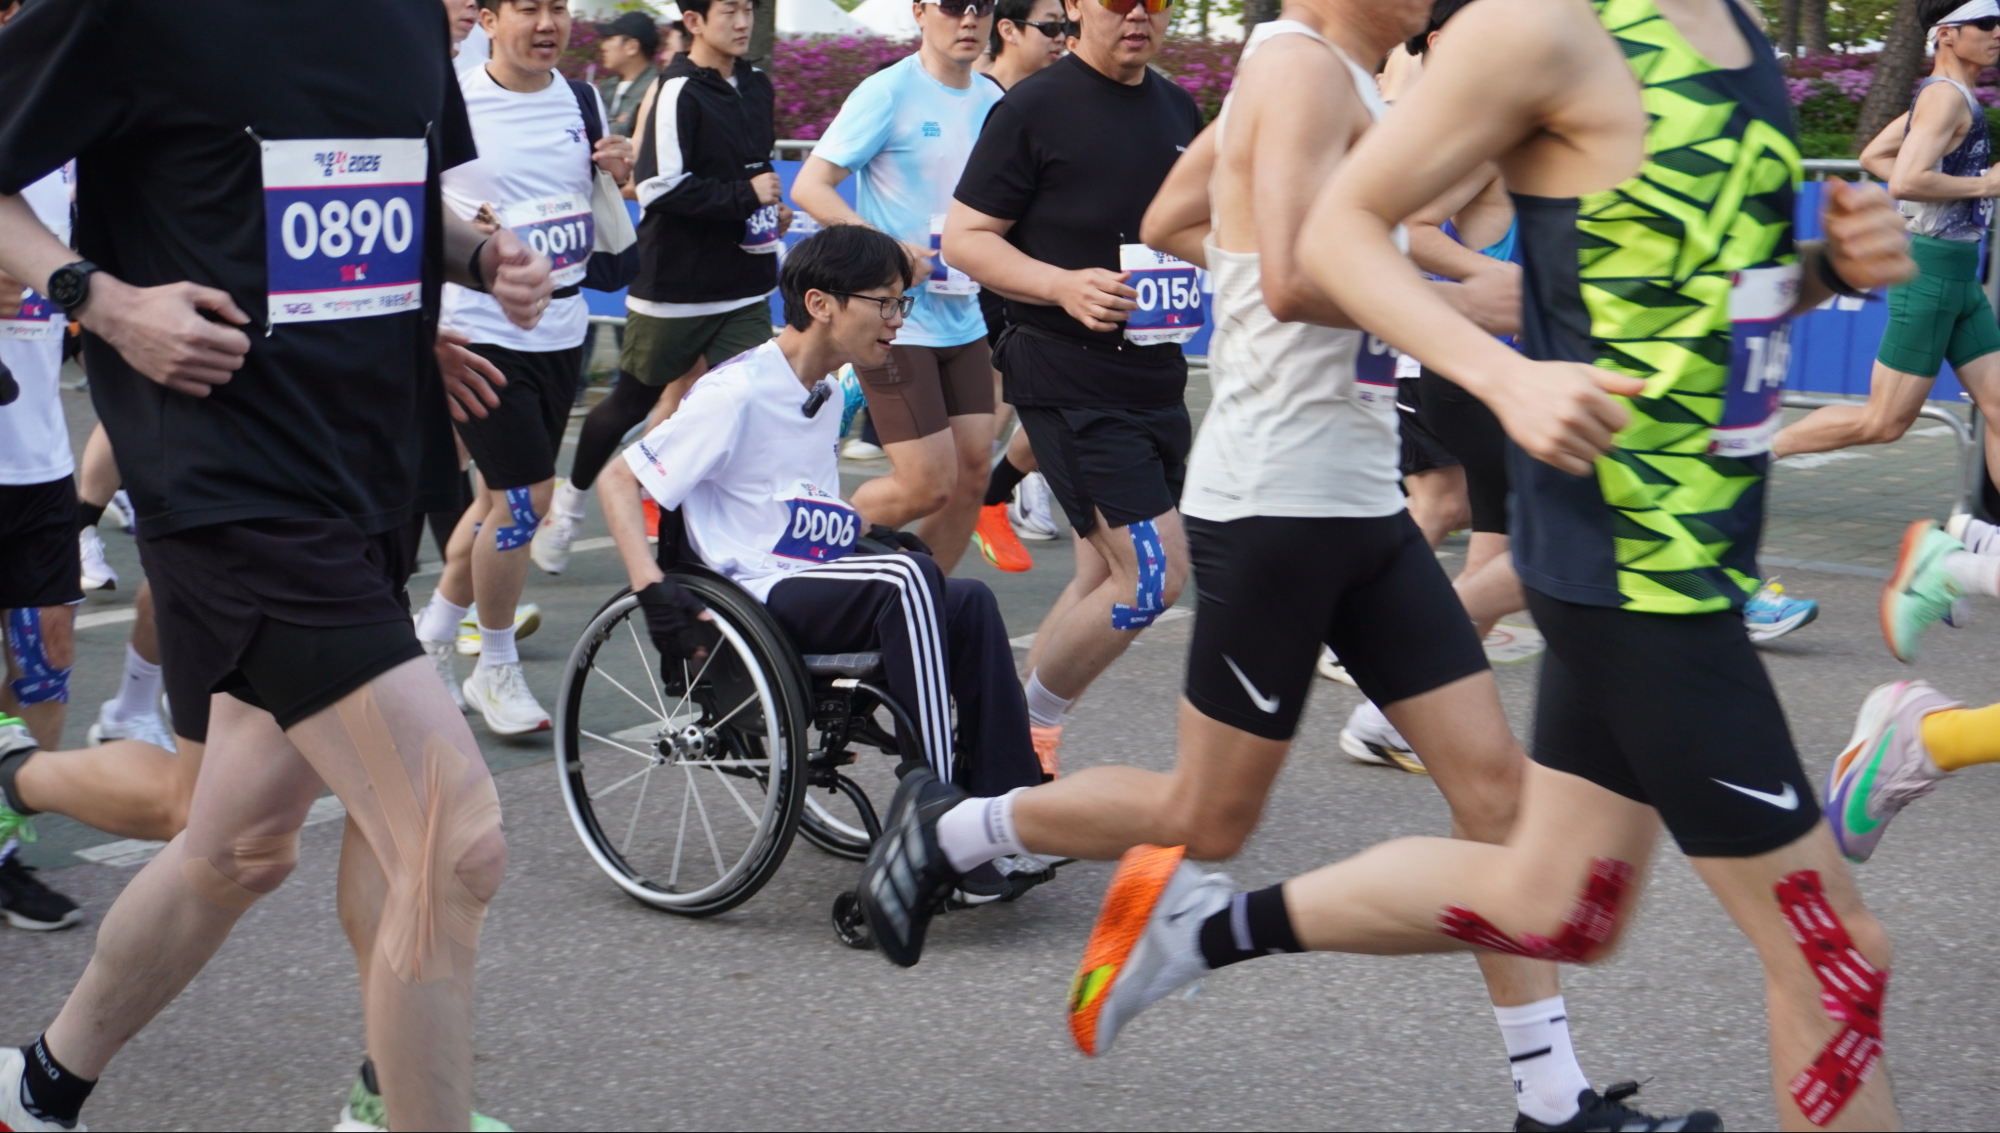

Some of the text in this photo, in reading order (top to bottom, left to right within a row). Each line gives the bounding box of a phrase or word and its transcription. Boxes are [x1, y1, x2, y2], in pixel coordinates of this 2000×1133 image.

[281, 197, 413, 260] 0890
[528, 221, 587, 257] 0011
[1136, 277, 1200, 311] 0156
[792, 507, 855, 547] 0006
